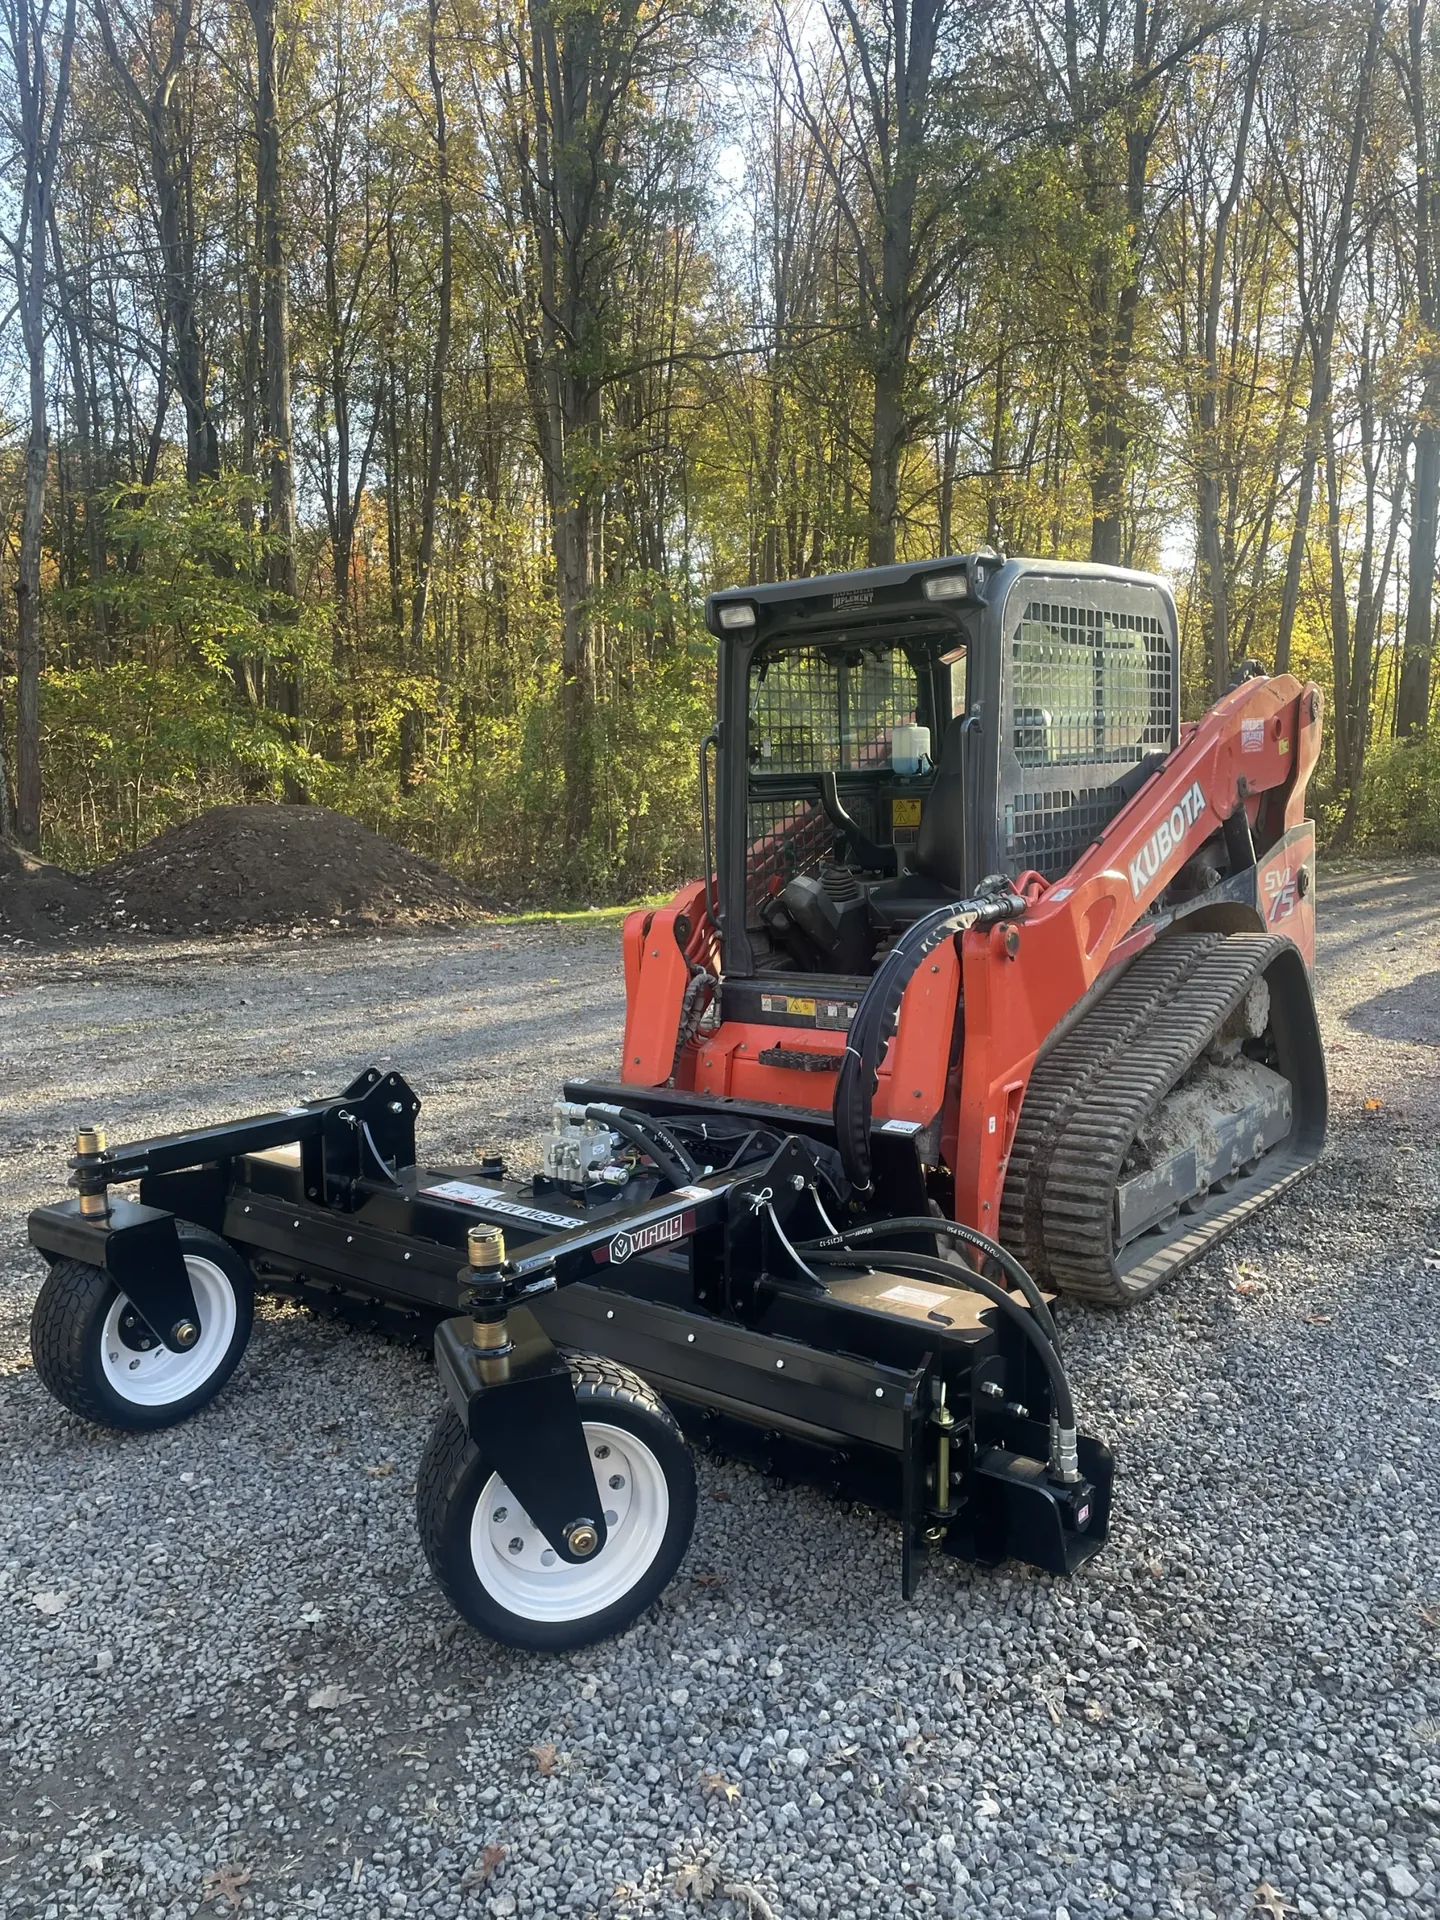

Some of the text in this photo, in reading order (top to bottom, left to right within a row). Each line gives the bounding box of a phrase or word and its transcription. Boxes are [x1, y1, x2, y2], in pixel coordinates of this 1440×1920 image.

[832, 592, 874, 609] IMPLEMENT
[1129, 780, 1206, 898] KUBOTA
[1264, 867, 1296, 892] SVL
[1268, 887, 1296, 921] 75
[481, 1199, 519, 1213] MAX
[519, 1208, 565, 1223] GPM
